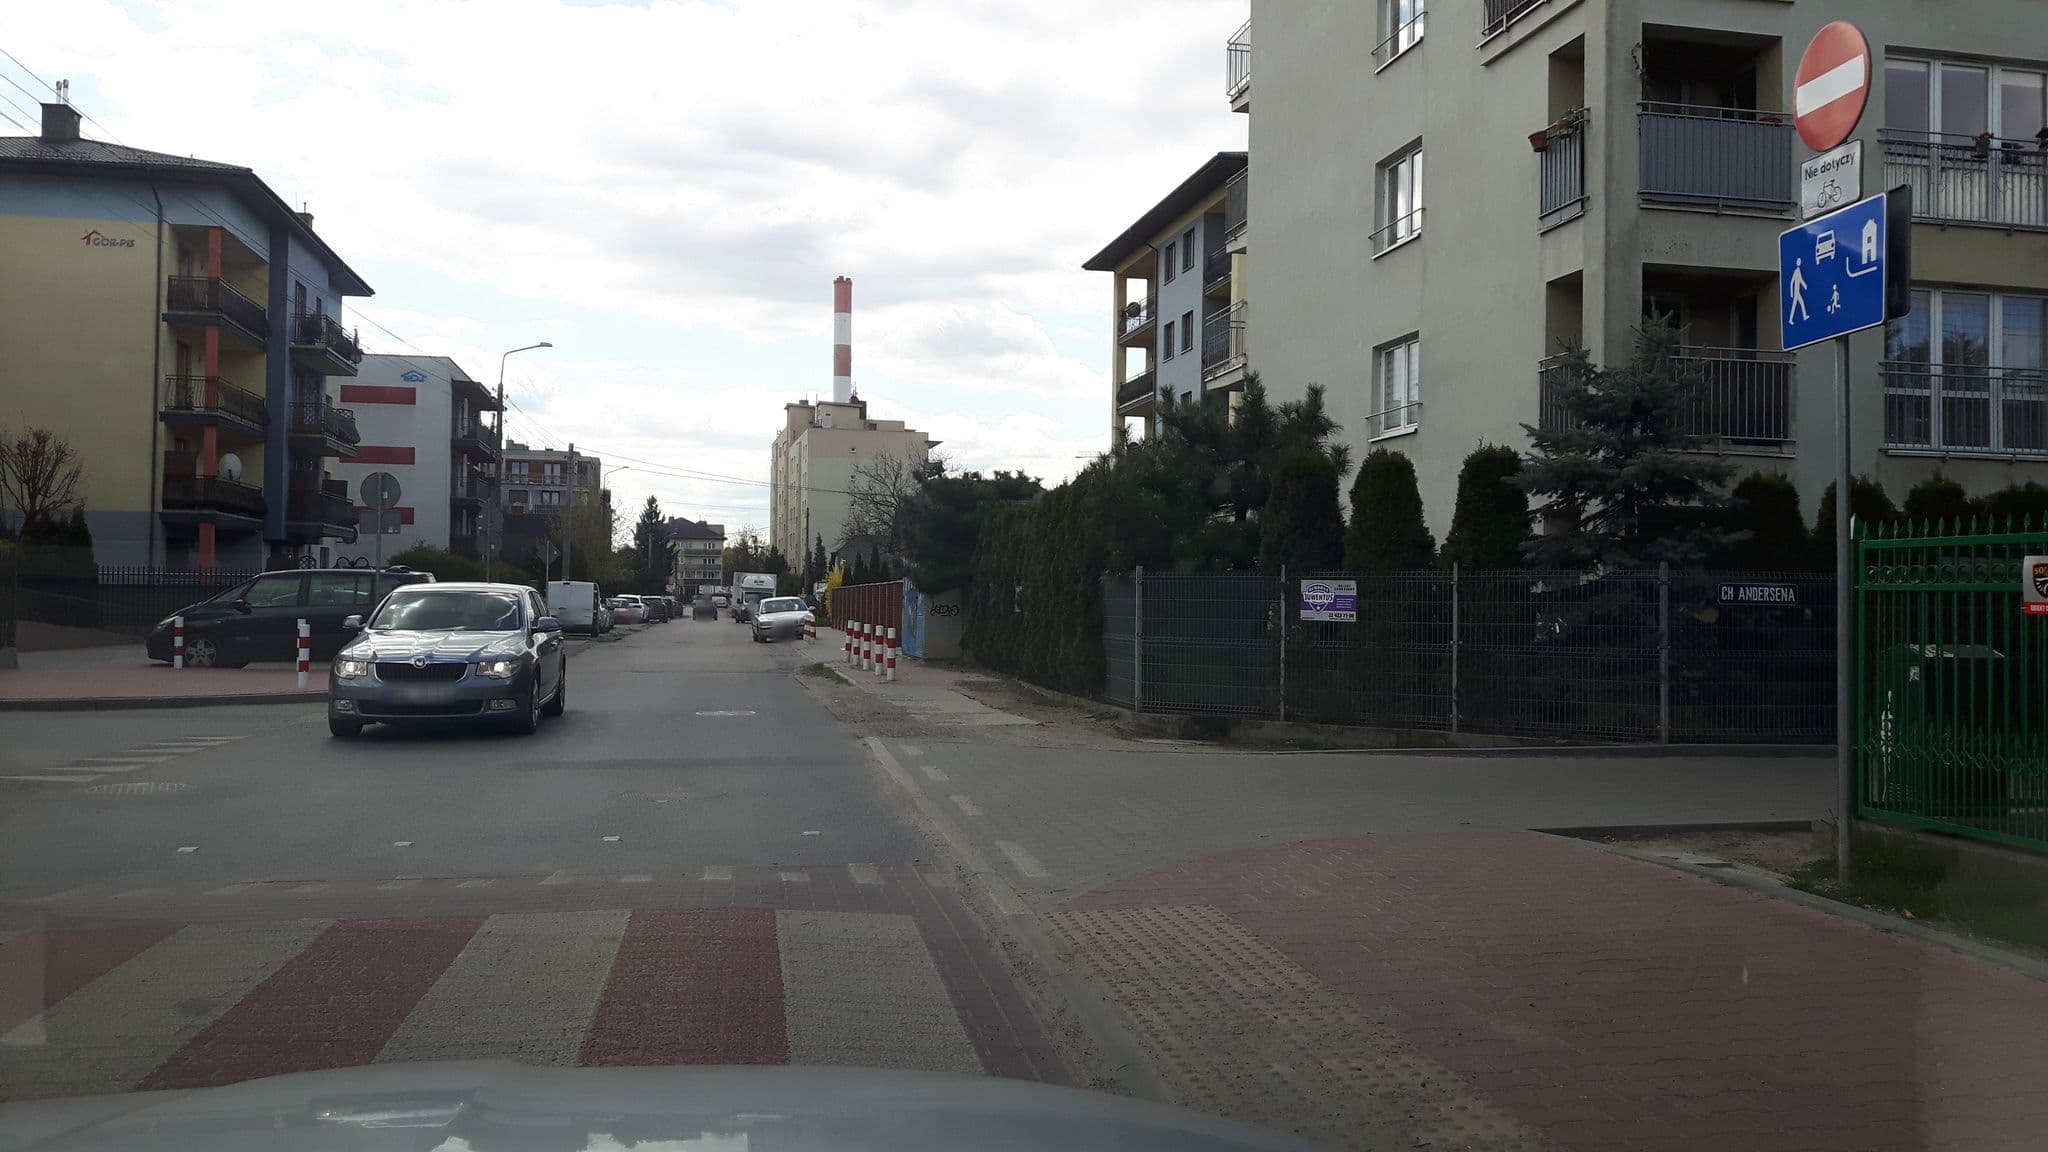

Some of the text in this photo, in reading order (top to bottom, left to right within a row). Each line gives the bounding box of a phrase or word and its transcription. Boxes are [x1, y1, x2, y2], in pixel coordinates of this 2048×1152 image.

[1805, 152, 1856, 180] Nie dotyczy
[1304, 593, 1334, 602] JUWENTUS
[1721, 586, 1796, 602] CH ANDERSENA
